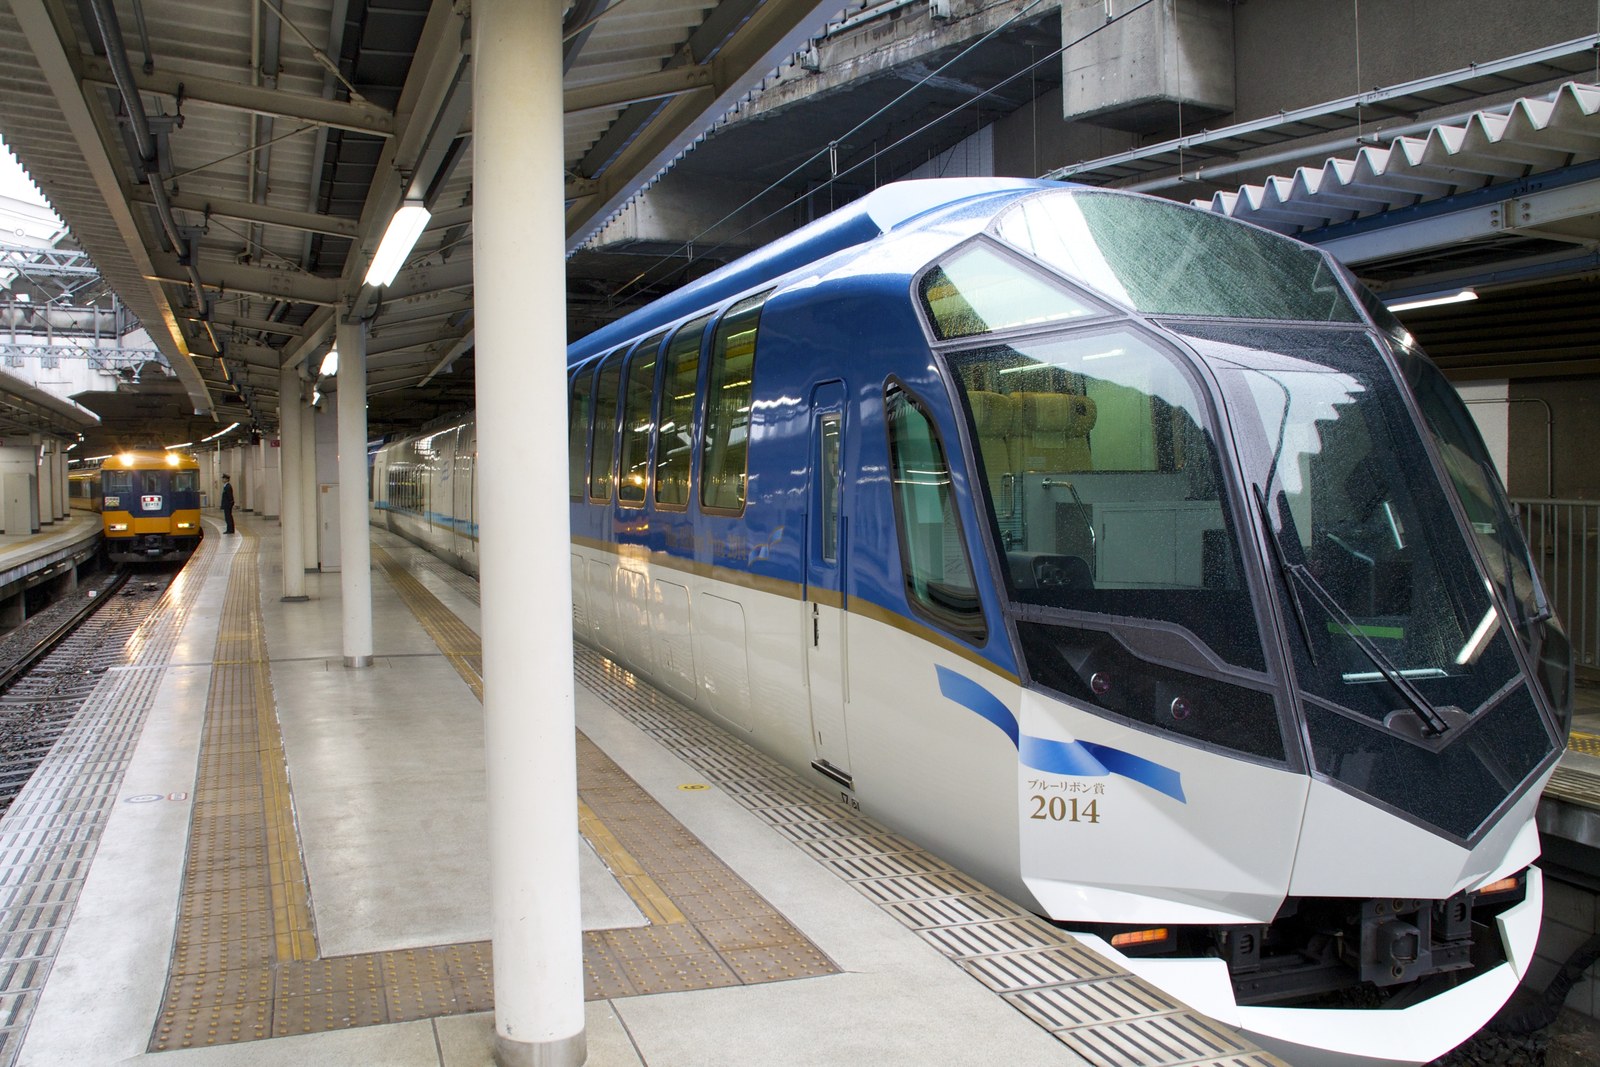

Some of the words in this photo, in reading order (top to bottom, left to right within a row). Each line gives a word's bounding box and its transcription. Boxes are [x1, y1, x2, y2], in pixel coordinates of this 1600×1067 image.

[1028, 779, 1105, 795] ブルーリボン賞
[1030, 795, 1100, 823] 2014
